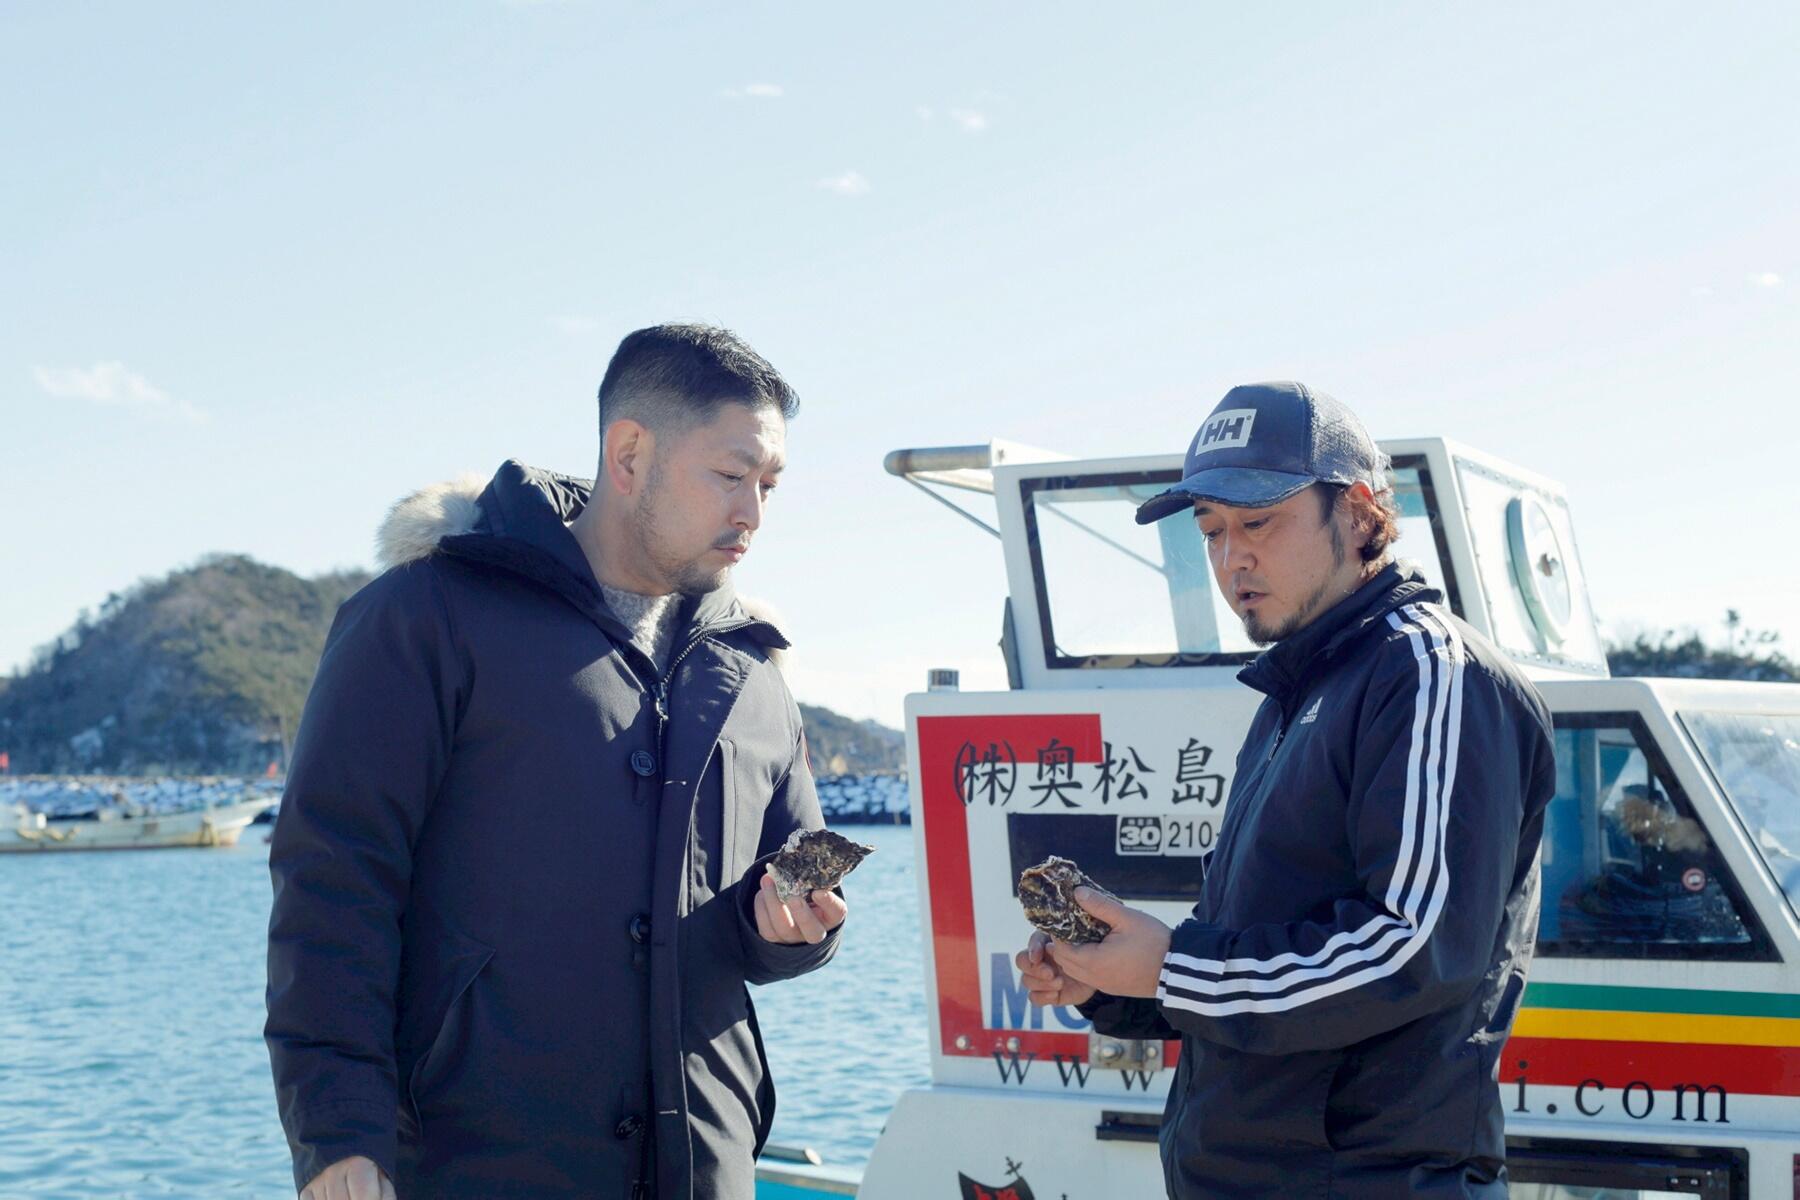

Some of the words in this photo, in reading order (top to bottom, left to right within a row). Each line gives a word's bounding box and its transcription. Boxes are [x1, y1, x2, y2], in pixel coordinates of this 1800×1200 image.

[1202, 417, 1245, 446] HH
[1120, 826, 1161, 846] 30
[991, 953, 1093, 1030] M
